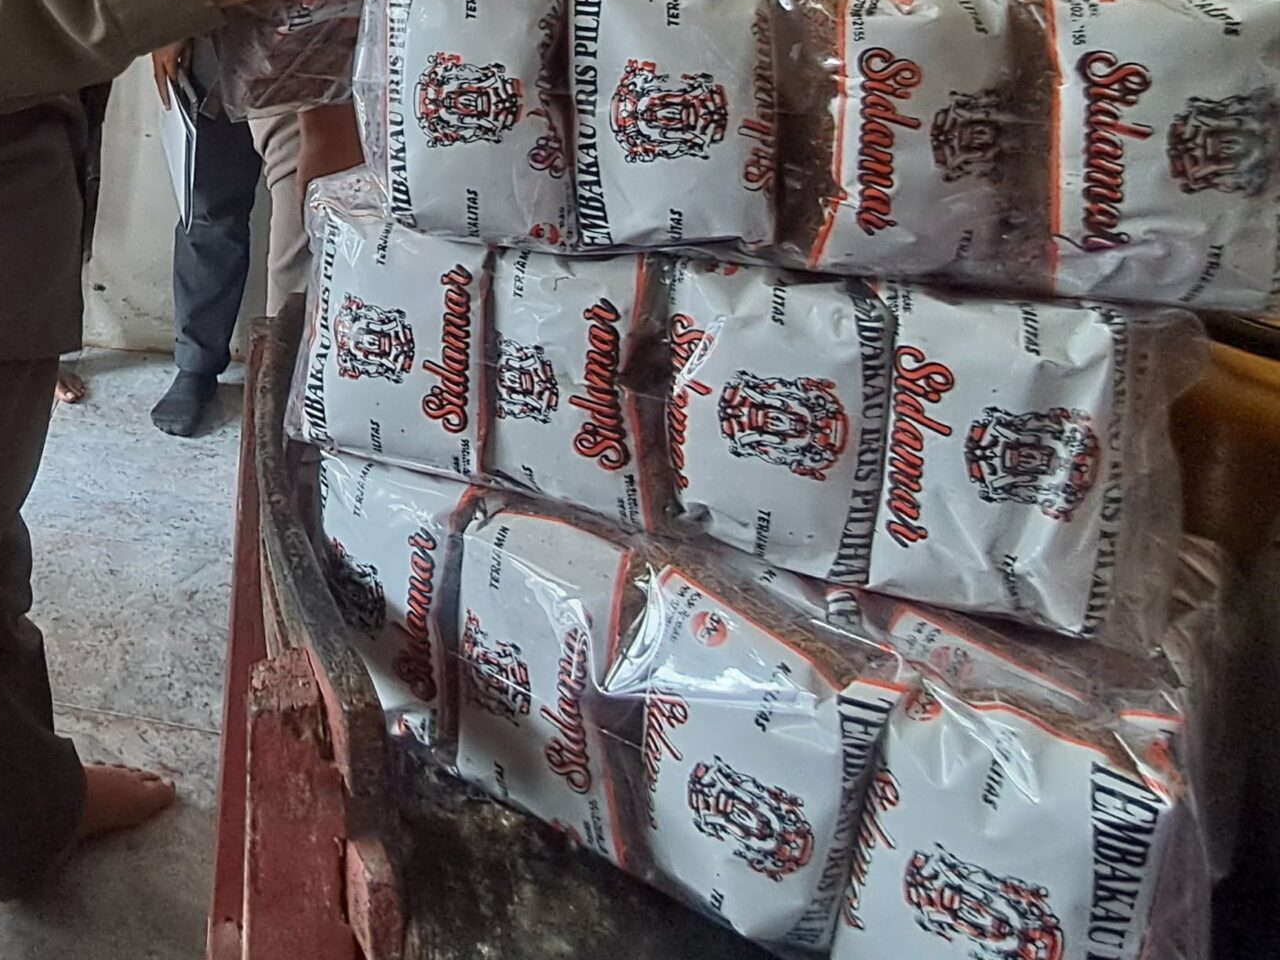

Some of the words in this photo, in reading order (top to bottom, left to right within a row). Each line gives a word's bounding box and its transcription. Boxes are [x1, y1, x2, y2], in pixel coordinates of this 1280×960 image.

[574, 64, 598, 119] IRIS
[857, 47, 922, 237] Sidamar
[1079, 50, 1154, 252] Sidamar
[389, 112, 416, 230] EMBAKAU
[576, 121, 615, 248] EMBAKAU
[304, 338, 332, 441] EMBAKAU
[422, 263, 474, 434] Sidamar
[568, 297, 632, 471] Sidamar
[854, 426, 880, 484] IRIS
[887, 344, 956, 549] Sidamar
[489, 526, 510, 591] TERJAMIN
[1086, 761, 1166, 949] TEMBAKAU
